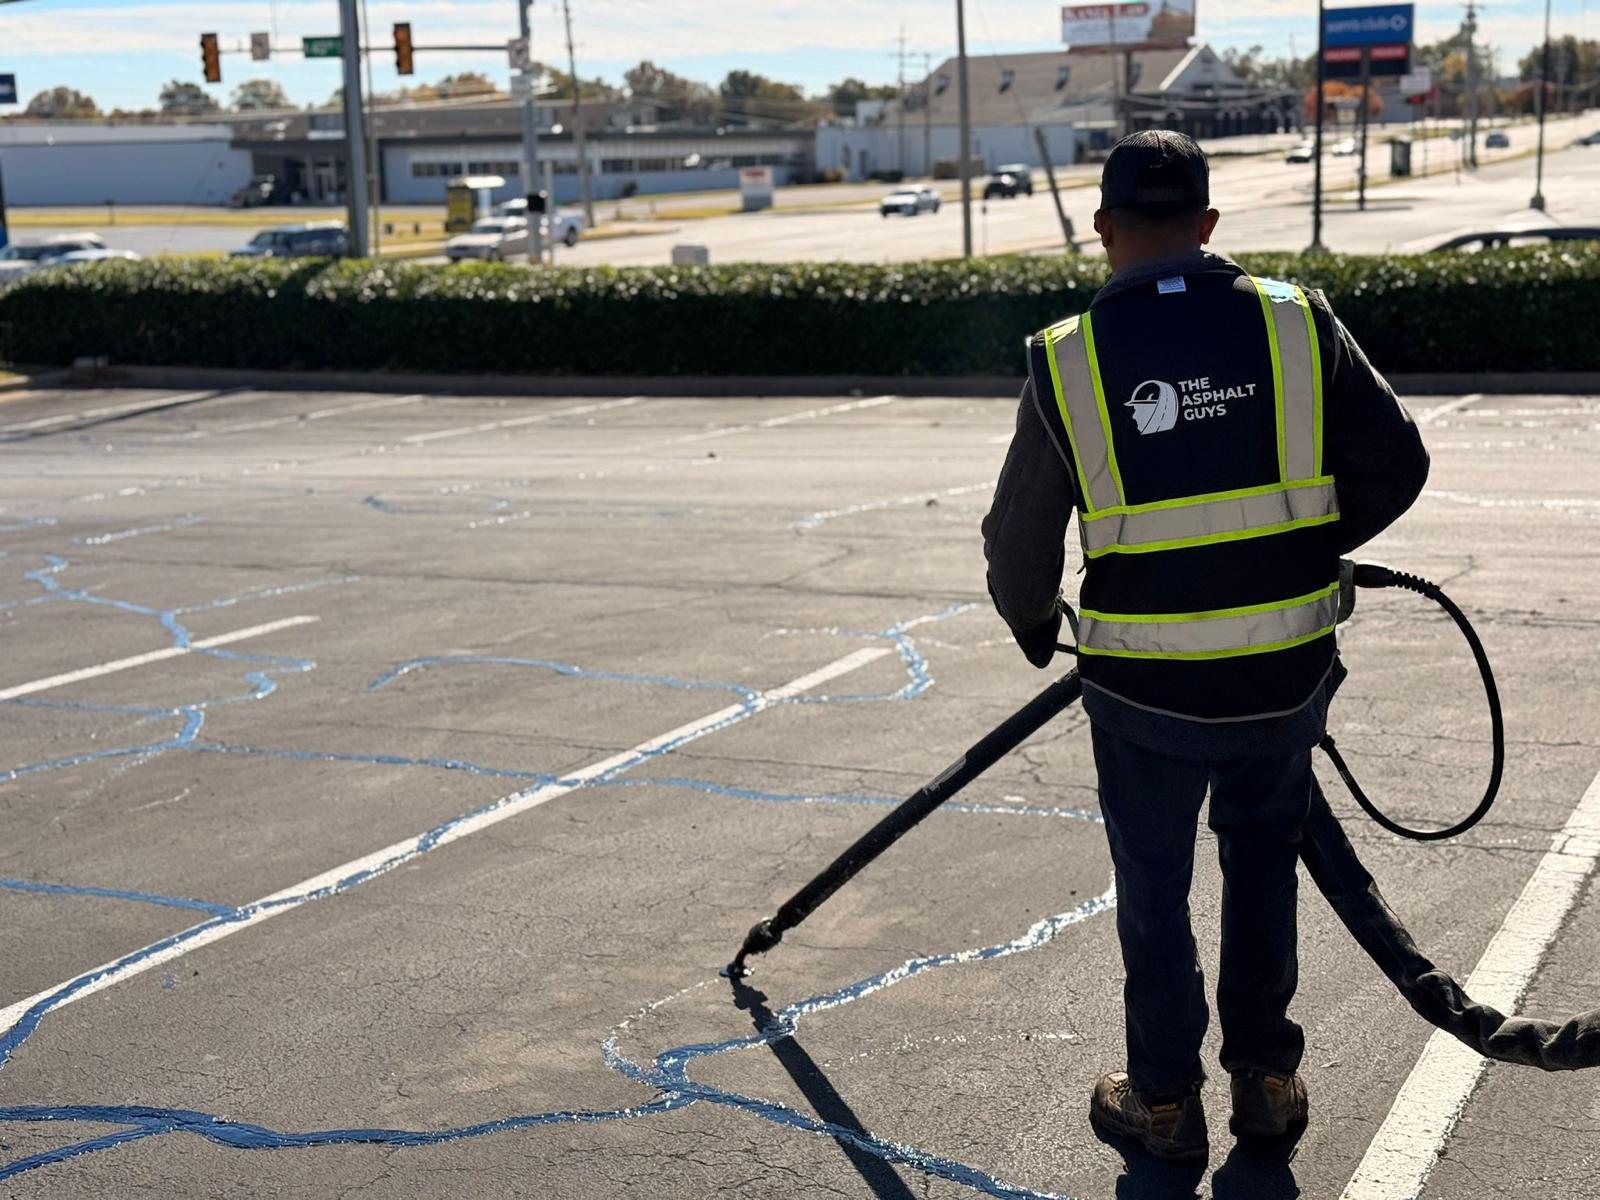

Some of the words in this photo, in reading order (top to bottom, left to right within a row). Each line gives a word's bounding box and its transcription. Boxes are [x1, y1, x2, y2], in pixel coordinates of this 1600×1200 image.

[1178, 377, 1210, 392] THE
[1182, 384, 1256, 407] ASPHALT
[1184, 404, 1227, 421] GUYS
